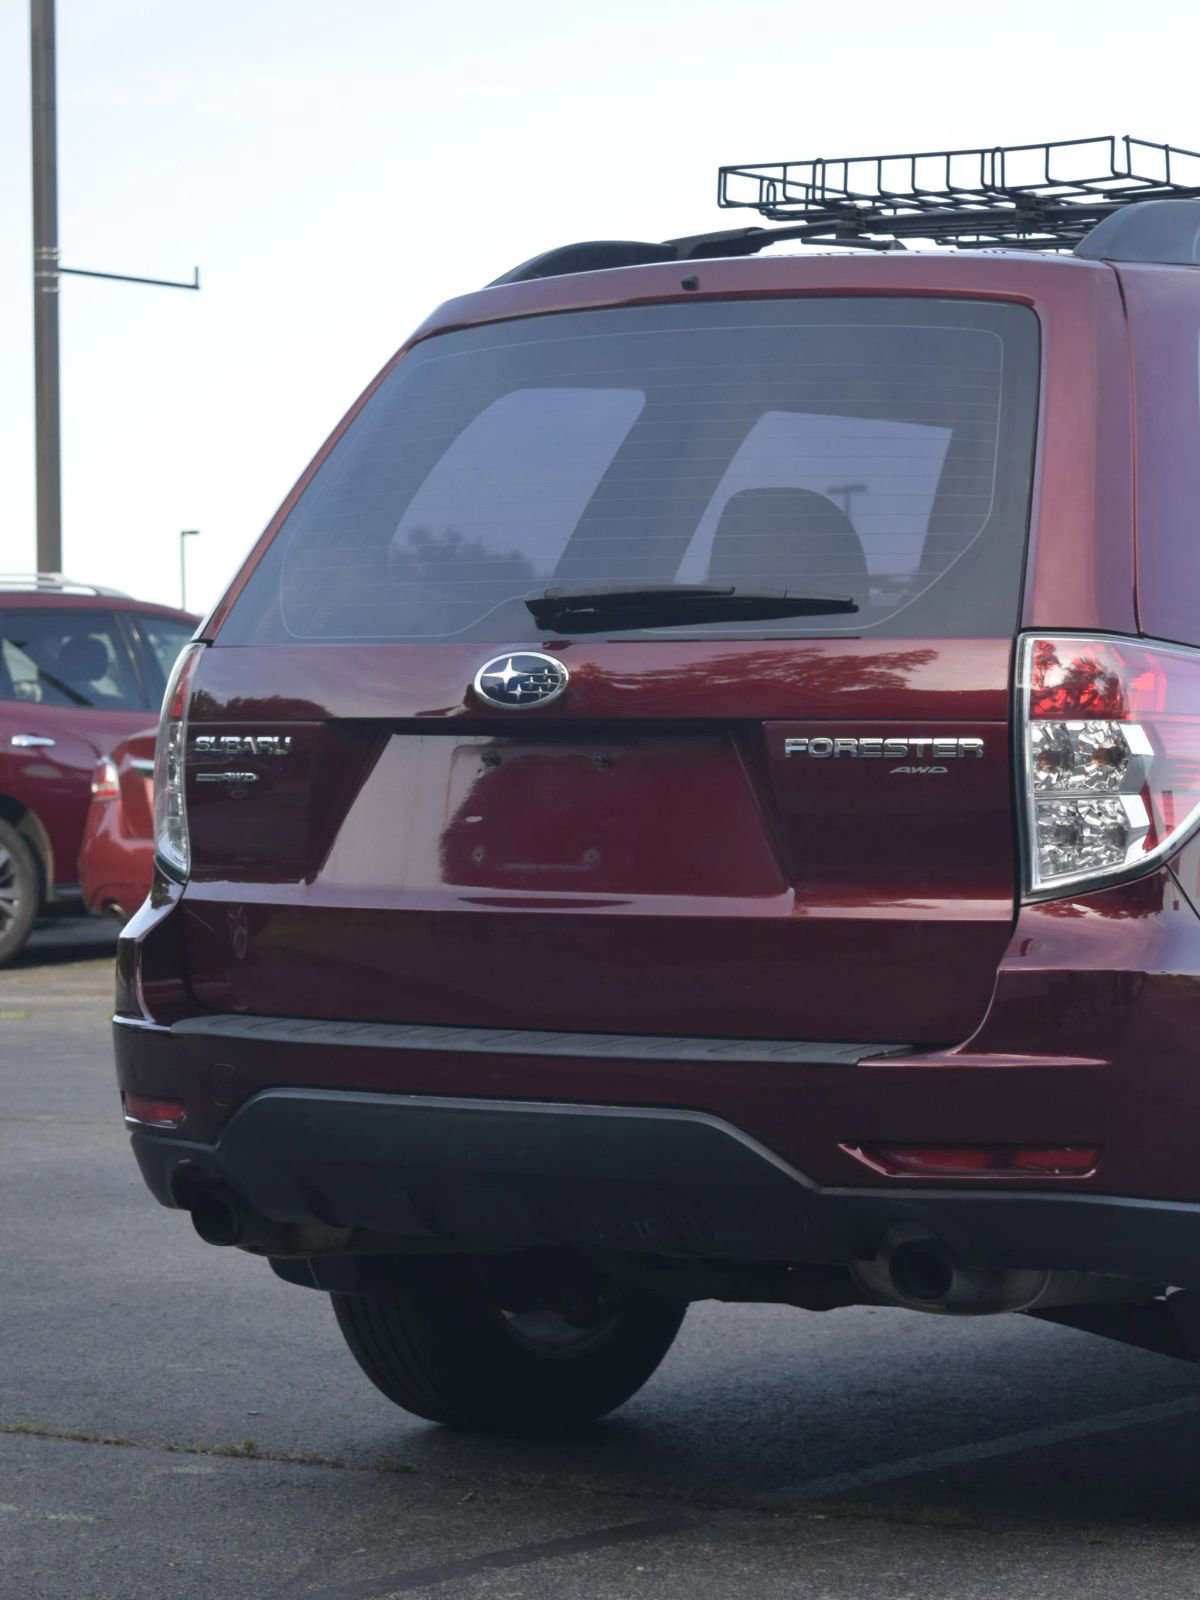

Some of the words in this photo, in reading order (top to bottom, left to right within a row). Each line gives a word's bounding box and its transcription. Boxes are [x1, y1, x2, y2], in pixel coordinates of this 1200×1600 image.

[194, 736, 292, 754] SUBARU
[784, 737, 984, 758] FORESTER
[889, 766, 948, 774] AWD
